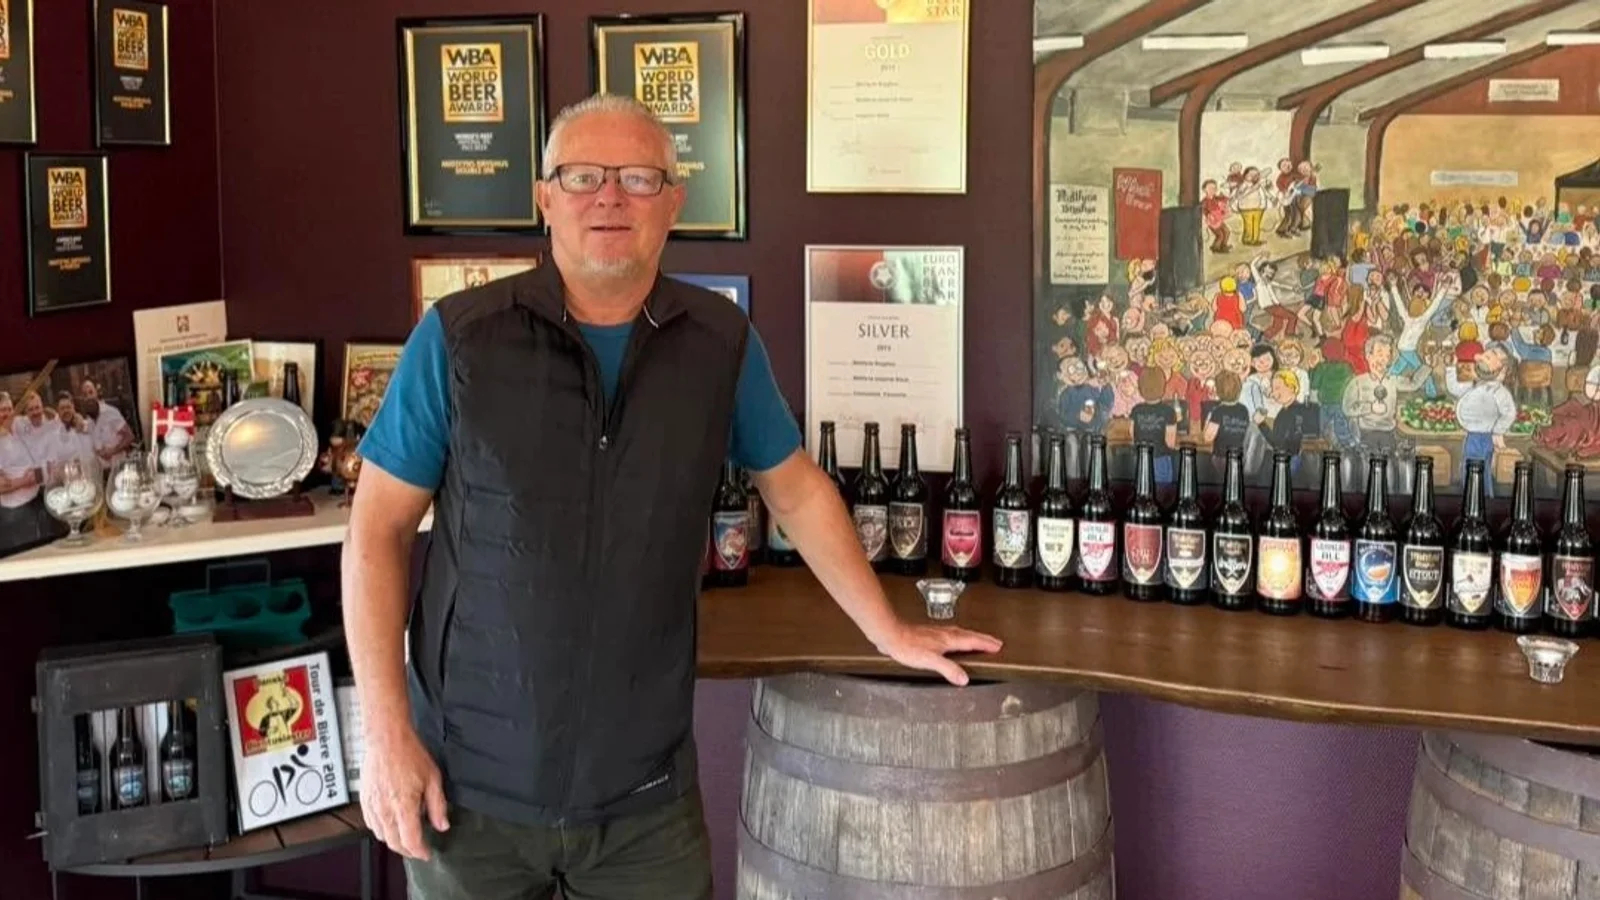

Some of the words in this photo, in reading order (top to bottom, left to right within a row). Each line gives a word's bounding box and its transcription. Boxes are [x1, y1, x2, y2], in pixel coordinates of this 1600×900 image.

[926, 6, 961, 17] STAR
[115, 12, 144, 28] WBA
[117, 40, 145, 55] BEER
[864, 43, 910, 60] GOLD
[446, 47, 496, 66] WBA
[640, 46, 692, 65] WBA
[447, 71, 498, 83] WORLD
[641, 70, 694, 83] WORLD
[448, 83, 497, 101] BEER
[642, 83, 693, 102] BEER
[449, 102, 499, 113] AWARDS
[51, 171, 83, 185] WBA
[52, 185, 84, 198] WORLD
[53, 198, 83, 214] BEER
[923, 254, 956, 264] EURO
[923, 266, 956, 276] PEAN
[923, 290, 956, 300] STAR
[858, 323, 910, 338] SILVER
[309, 662, 322, 694] Tour
[314, 699, 326, 716] de
[317, 720, 331, 759] Bière
[322, 763, 339, 799] 2014
